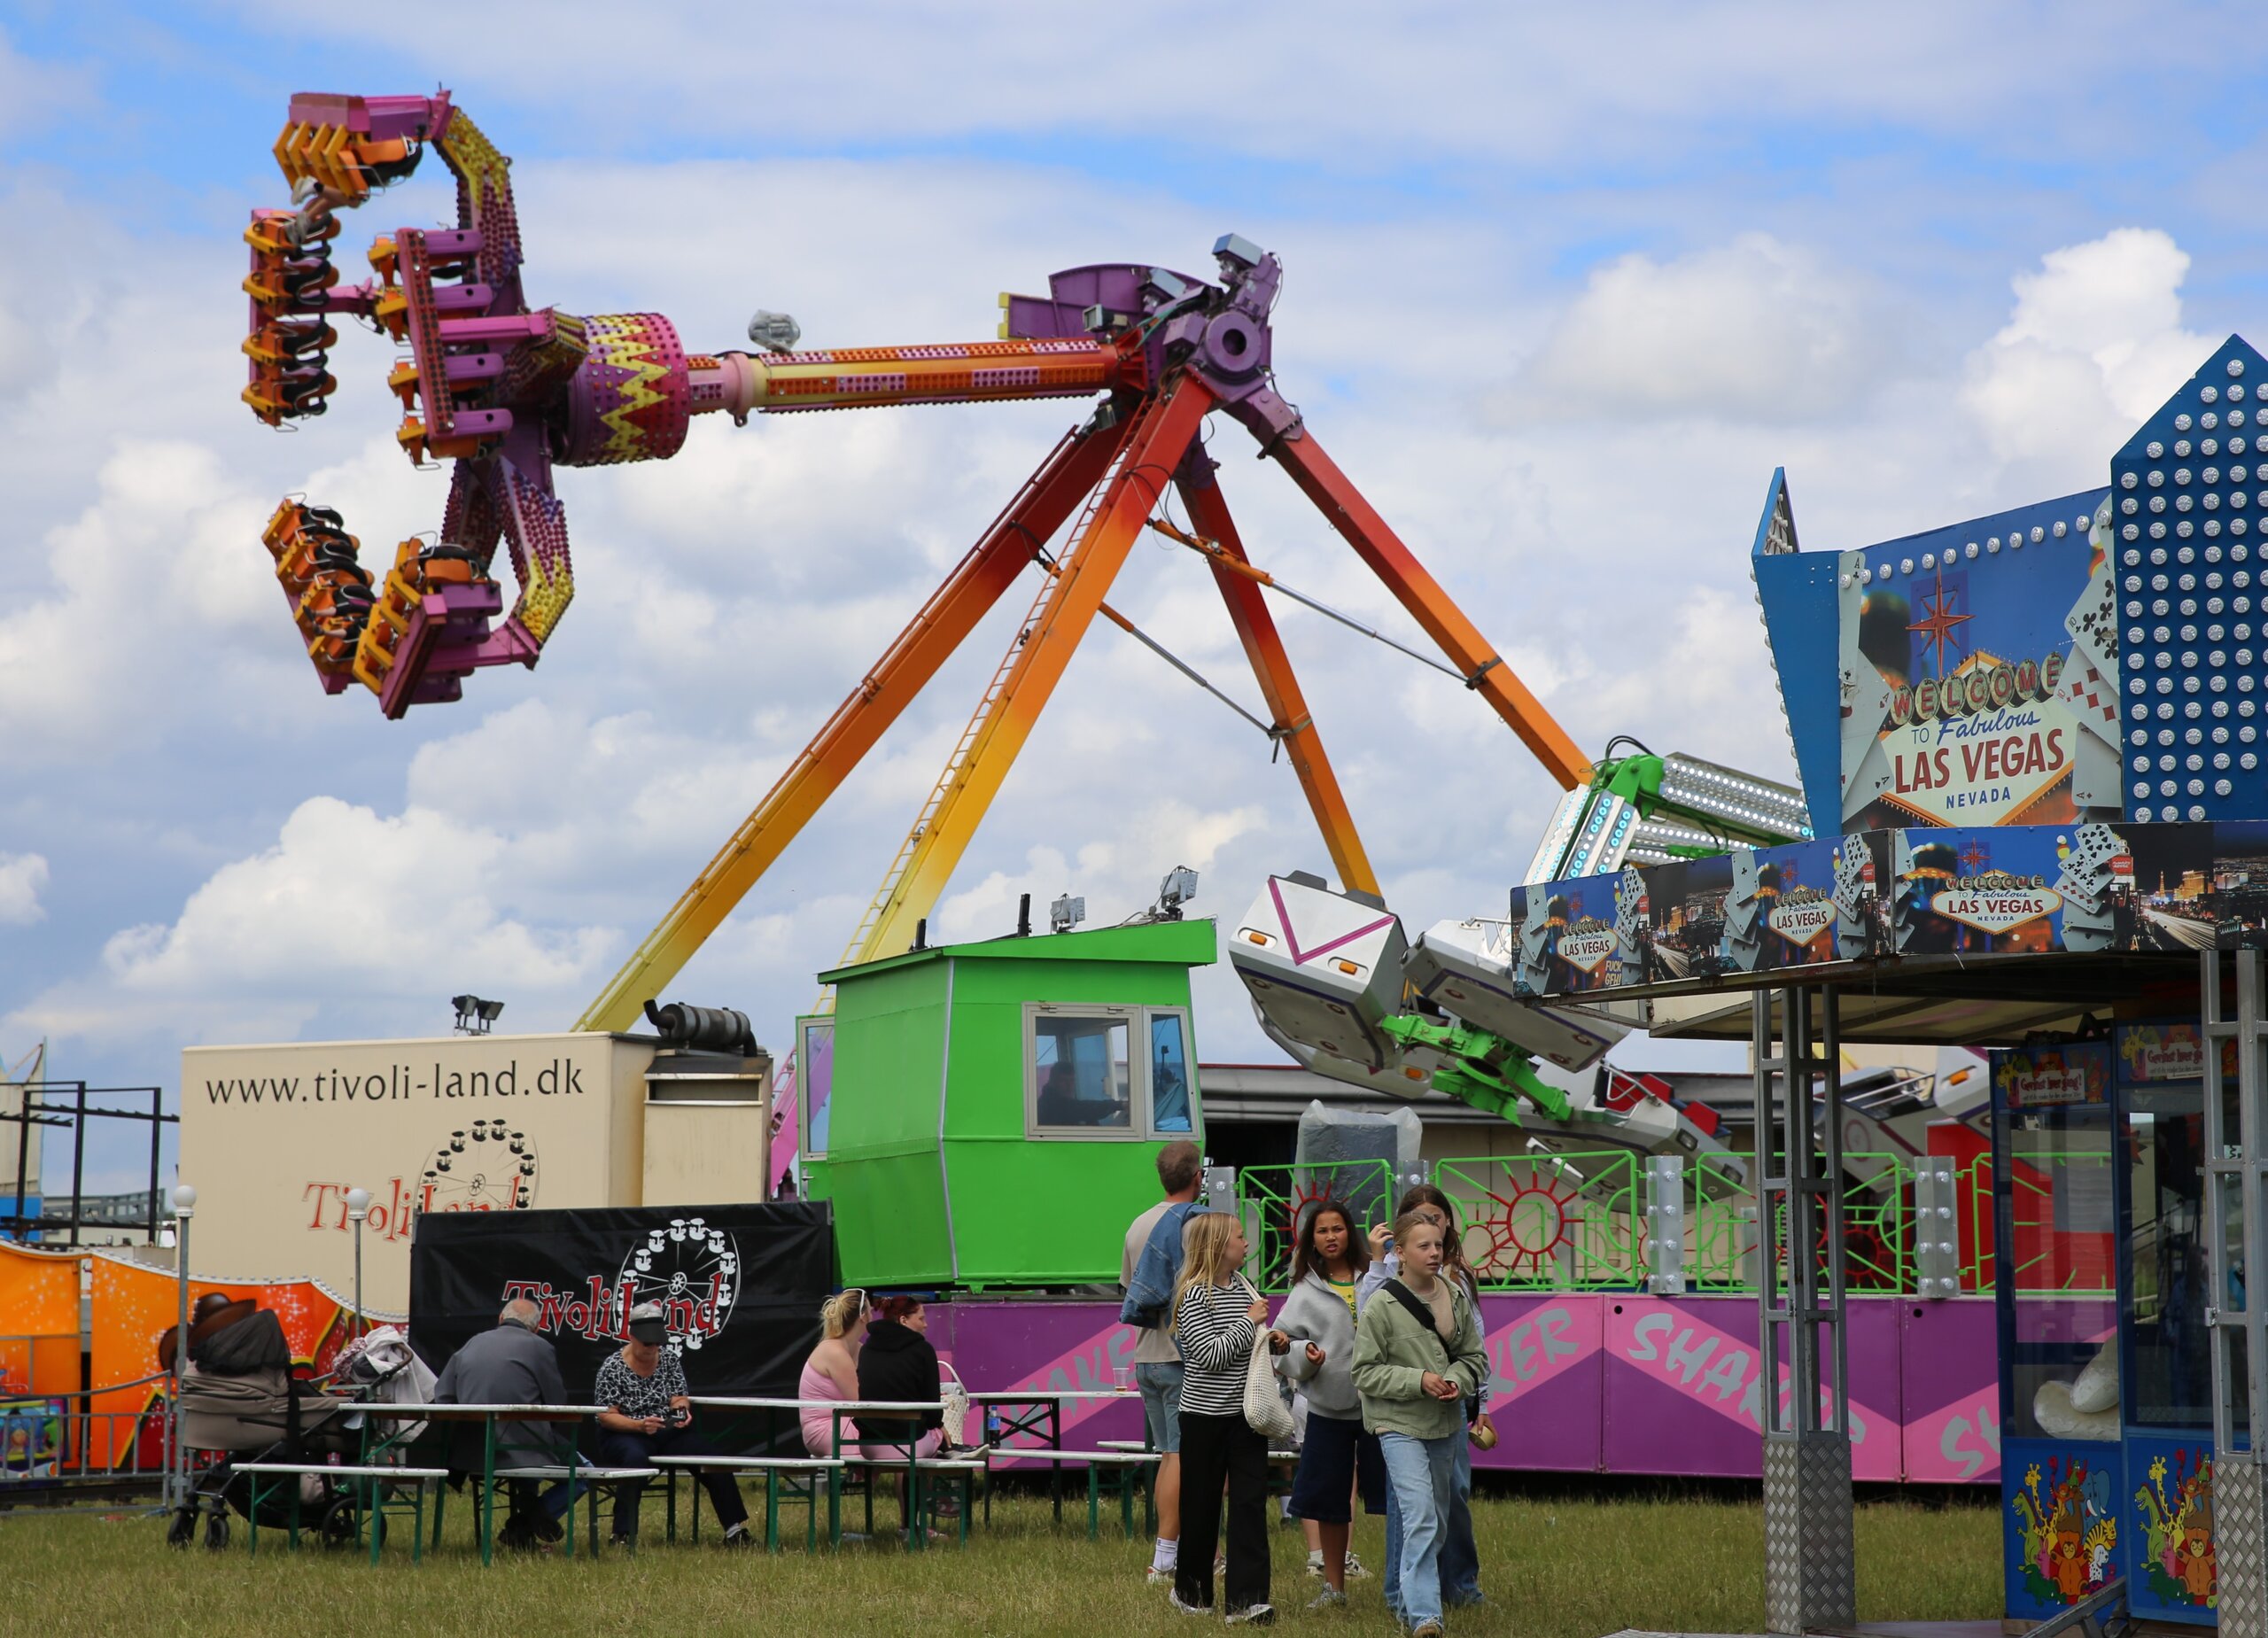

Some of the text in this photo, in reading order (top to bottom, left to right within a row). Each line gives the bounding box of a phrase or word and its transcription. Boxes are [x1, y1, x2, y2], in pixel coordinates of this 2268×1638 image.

[1891, 659, 2062, 719] WELCOME
[1911, 708, 2041, 746] TO Fabulous
[1895, 728, 2064, 795] LAS VEGAS
[1946, 786, 2011, 810] NEVADA
[1946, 875, 2044, 889] WELCOME
[1971, 889, 2031, 899] Fabulous
[1948, 899, 2044, 914] LAS VEGAS
[1776, 911, 1828, 929] LAS VEGAS
[1564, 939, 1610, 957] LAS VEGAS
[1604, 959, 1623, 973] FUCK
[206, 1059, 585, 1105] www.tivoli-land.dk
